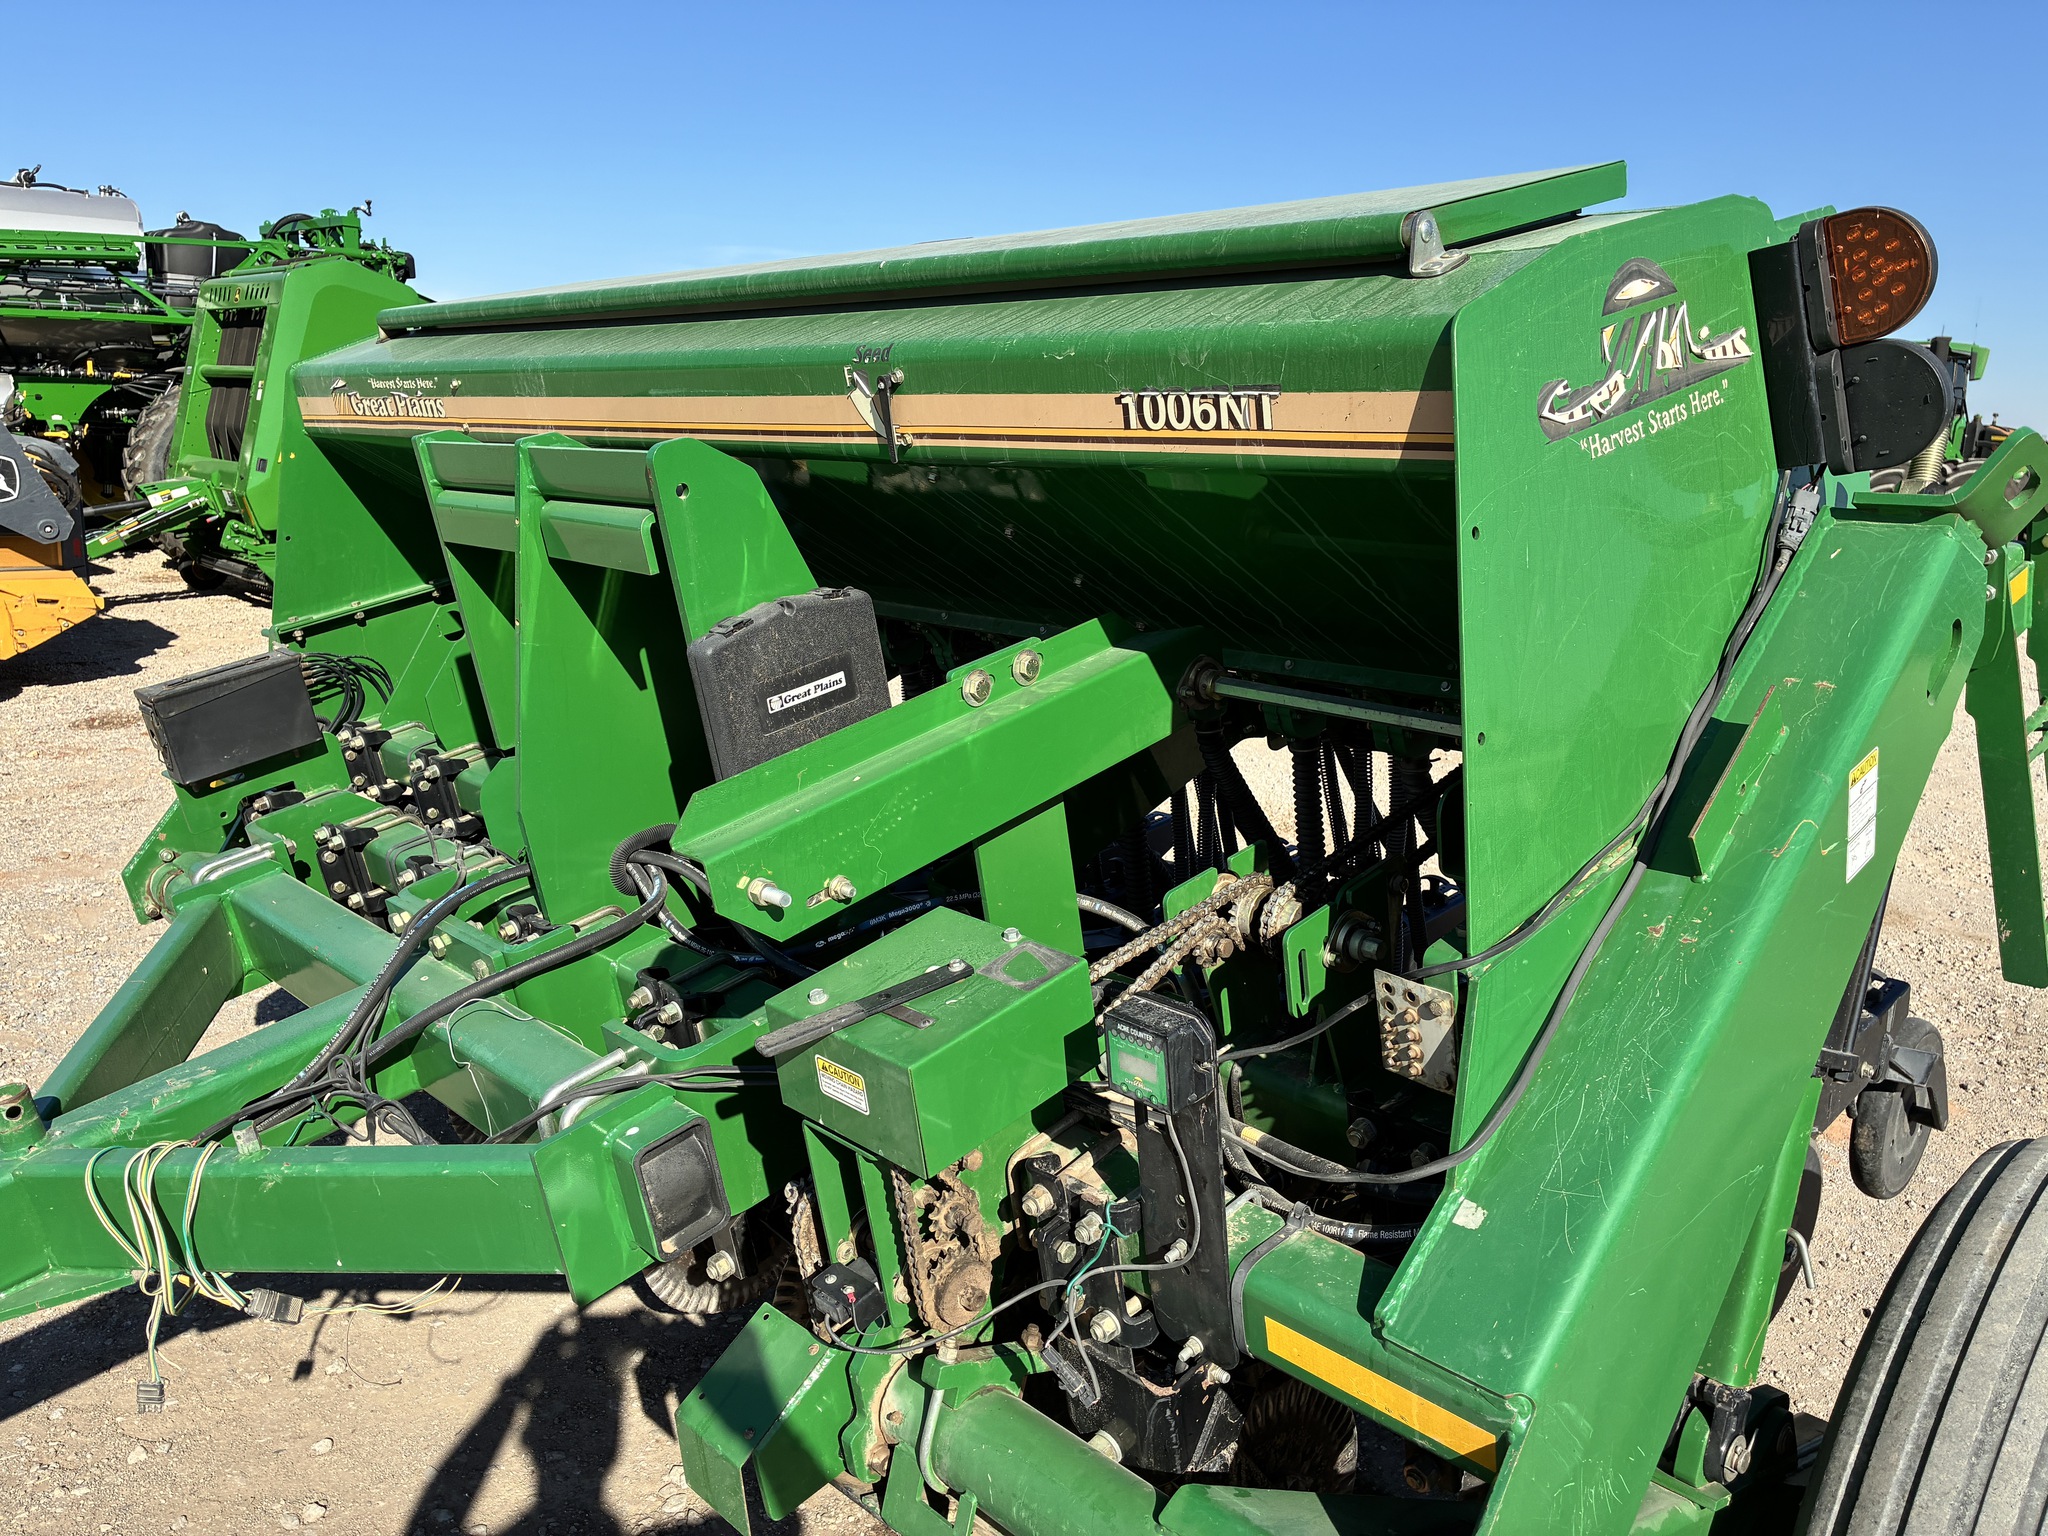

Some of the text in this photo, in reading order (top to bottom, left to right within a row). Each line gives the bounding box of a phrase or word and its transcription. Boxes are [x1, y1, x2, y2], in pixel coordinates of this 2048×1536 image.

[852, 343, 894, 364] Seed
[348, 392, 447, 418] Great Plains
[1114, 388, 1277, 431] 1006NT
[1648, 402, 1688, 434] Starts
[783, 677, 843, 704] Great Plains
[1116, 1023, 1154, 1042] ACRE COUNTER
[827, 1064, 861, 1088] CAUTION
[1358, 1229, 1379, 1239] Flame
[1380, 1229, 1412, 1239] Resistant
